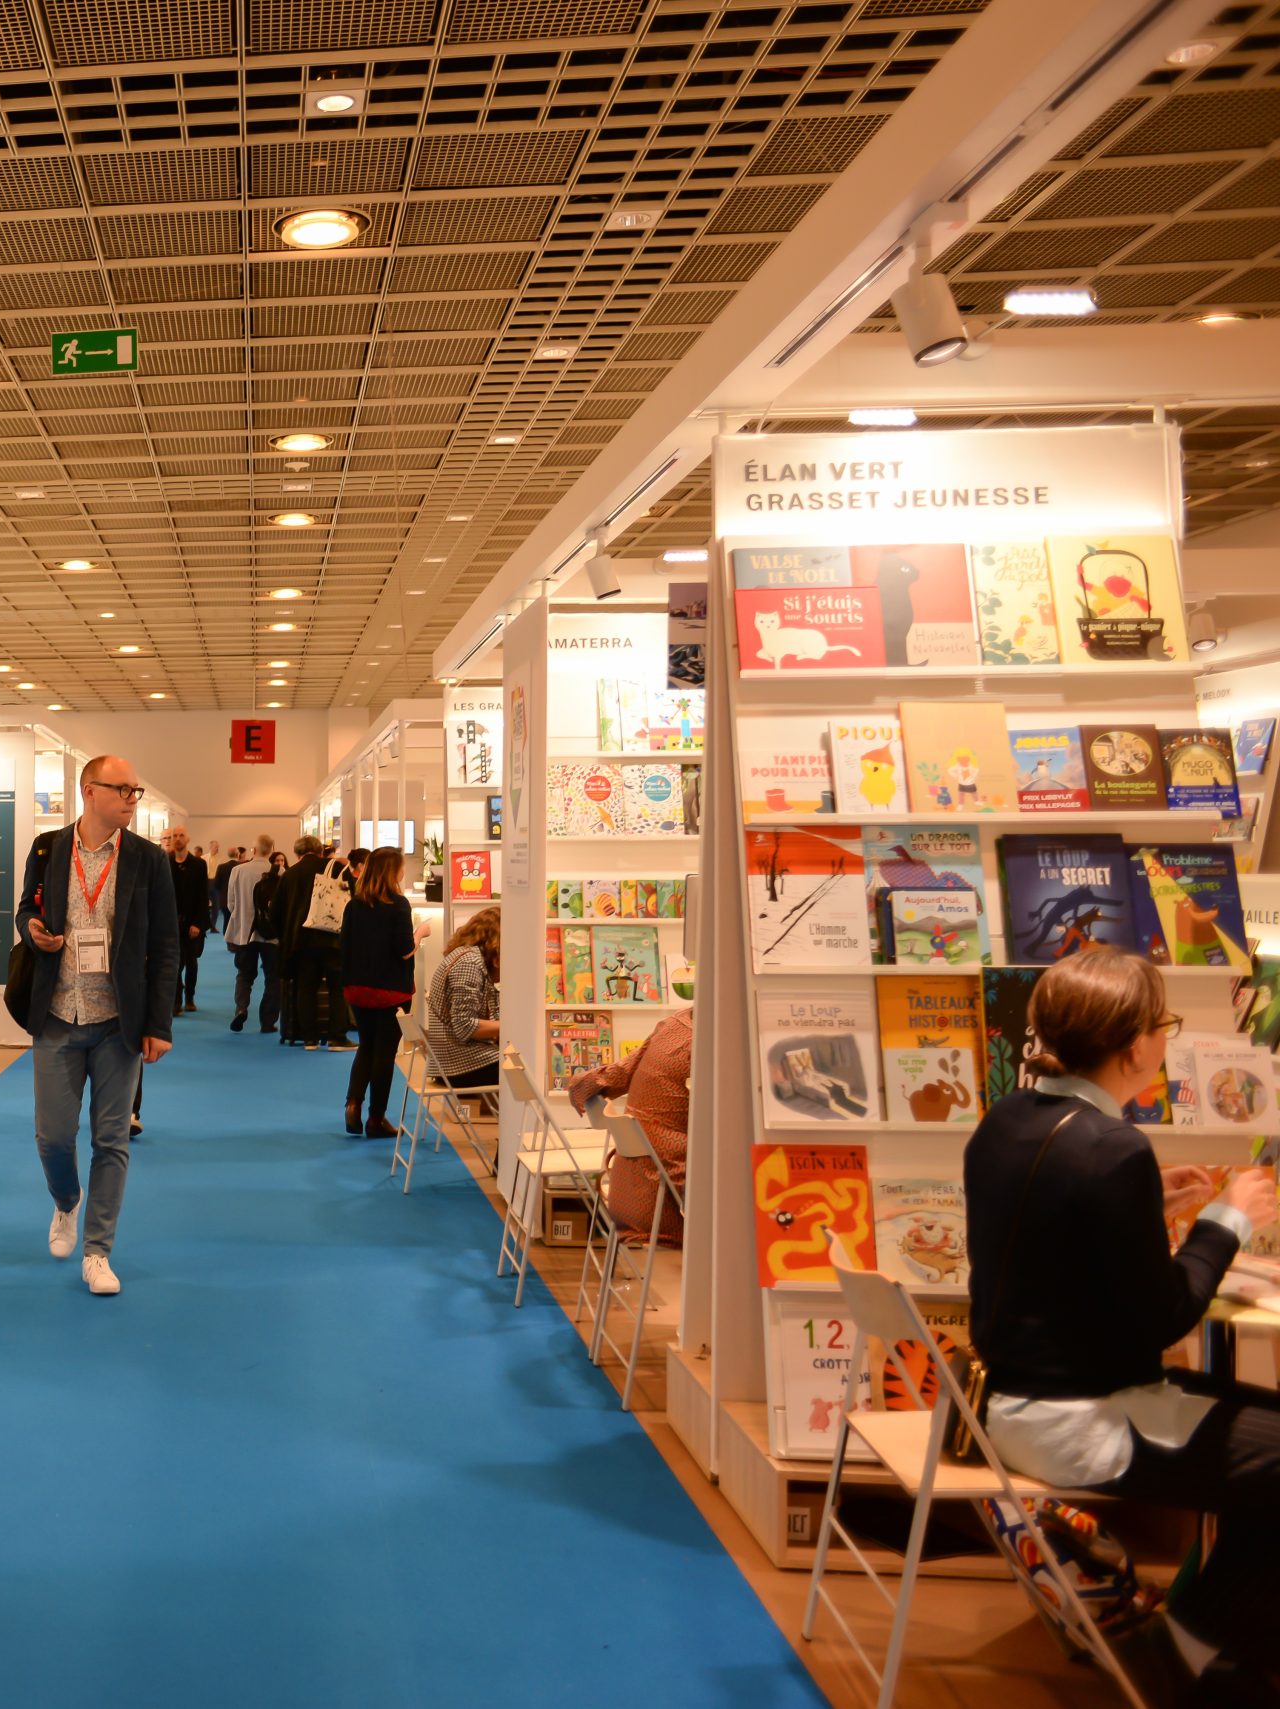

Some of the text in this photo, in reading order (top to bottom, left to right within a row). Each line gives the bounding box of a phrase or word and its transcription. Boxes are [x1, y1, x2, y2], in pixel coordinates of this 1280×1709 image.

[744, 458, 904, 483] ÉLAN VERT
[746, 486, 1051, 512] GRASSET JEUNESSE
[750, 555, 803, 569] VALSE
[783, 595, 862, 614] Si j'étais
[804, 609, 864, 625] souris
[1202, 688, 1231, 700] MELODY
[453, 702, 474, 711] LES
[245, 726, 262, 752] E
[1014, 736, 1070, 749] JONAS
[751, 768, 788, 777] POUR
[792, 768, 808, 777] LA
[1038, 849, 1089, 867] LE LOUP
[1062, 867, 1111, 886] SECRET
[937, 904, 969, 913] Amos
[809, 923, 847, 936] L'Homme
[825, 936, 859, 949] marche
[907, 995, 976, 1010] TABLEAUX
[790, 1004, 842, 1018] Le Loup
[778, 1017, 856, 1028] ne viendra pas
[909, 1014, 978, 1028] HISTOIRES
[898, 1058, 909, 1066] tu
